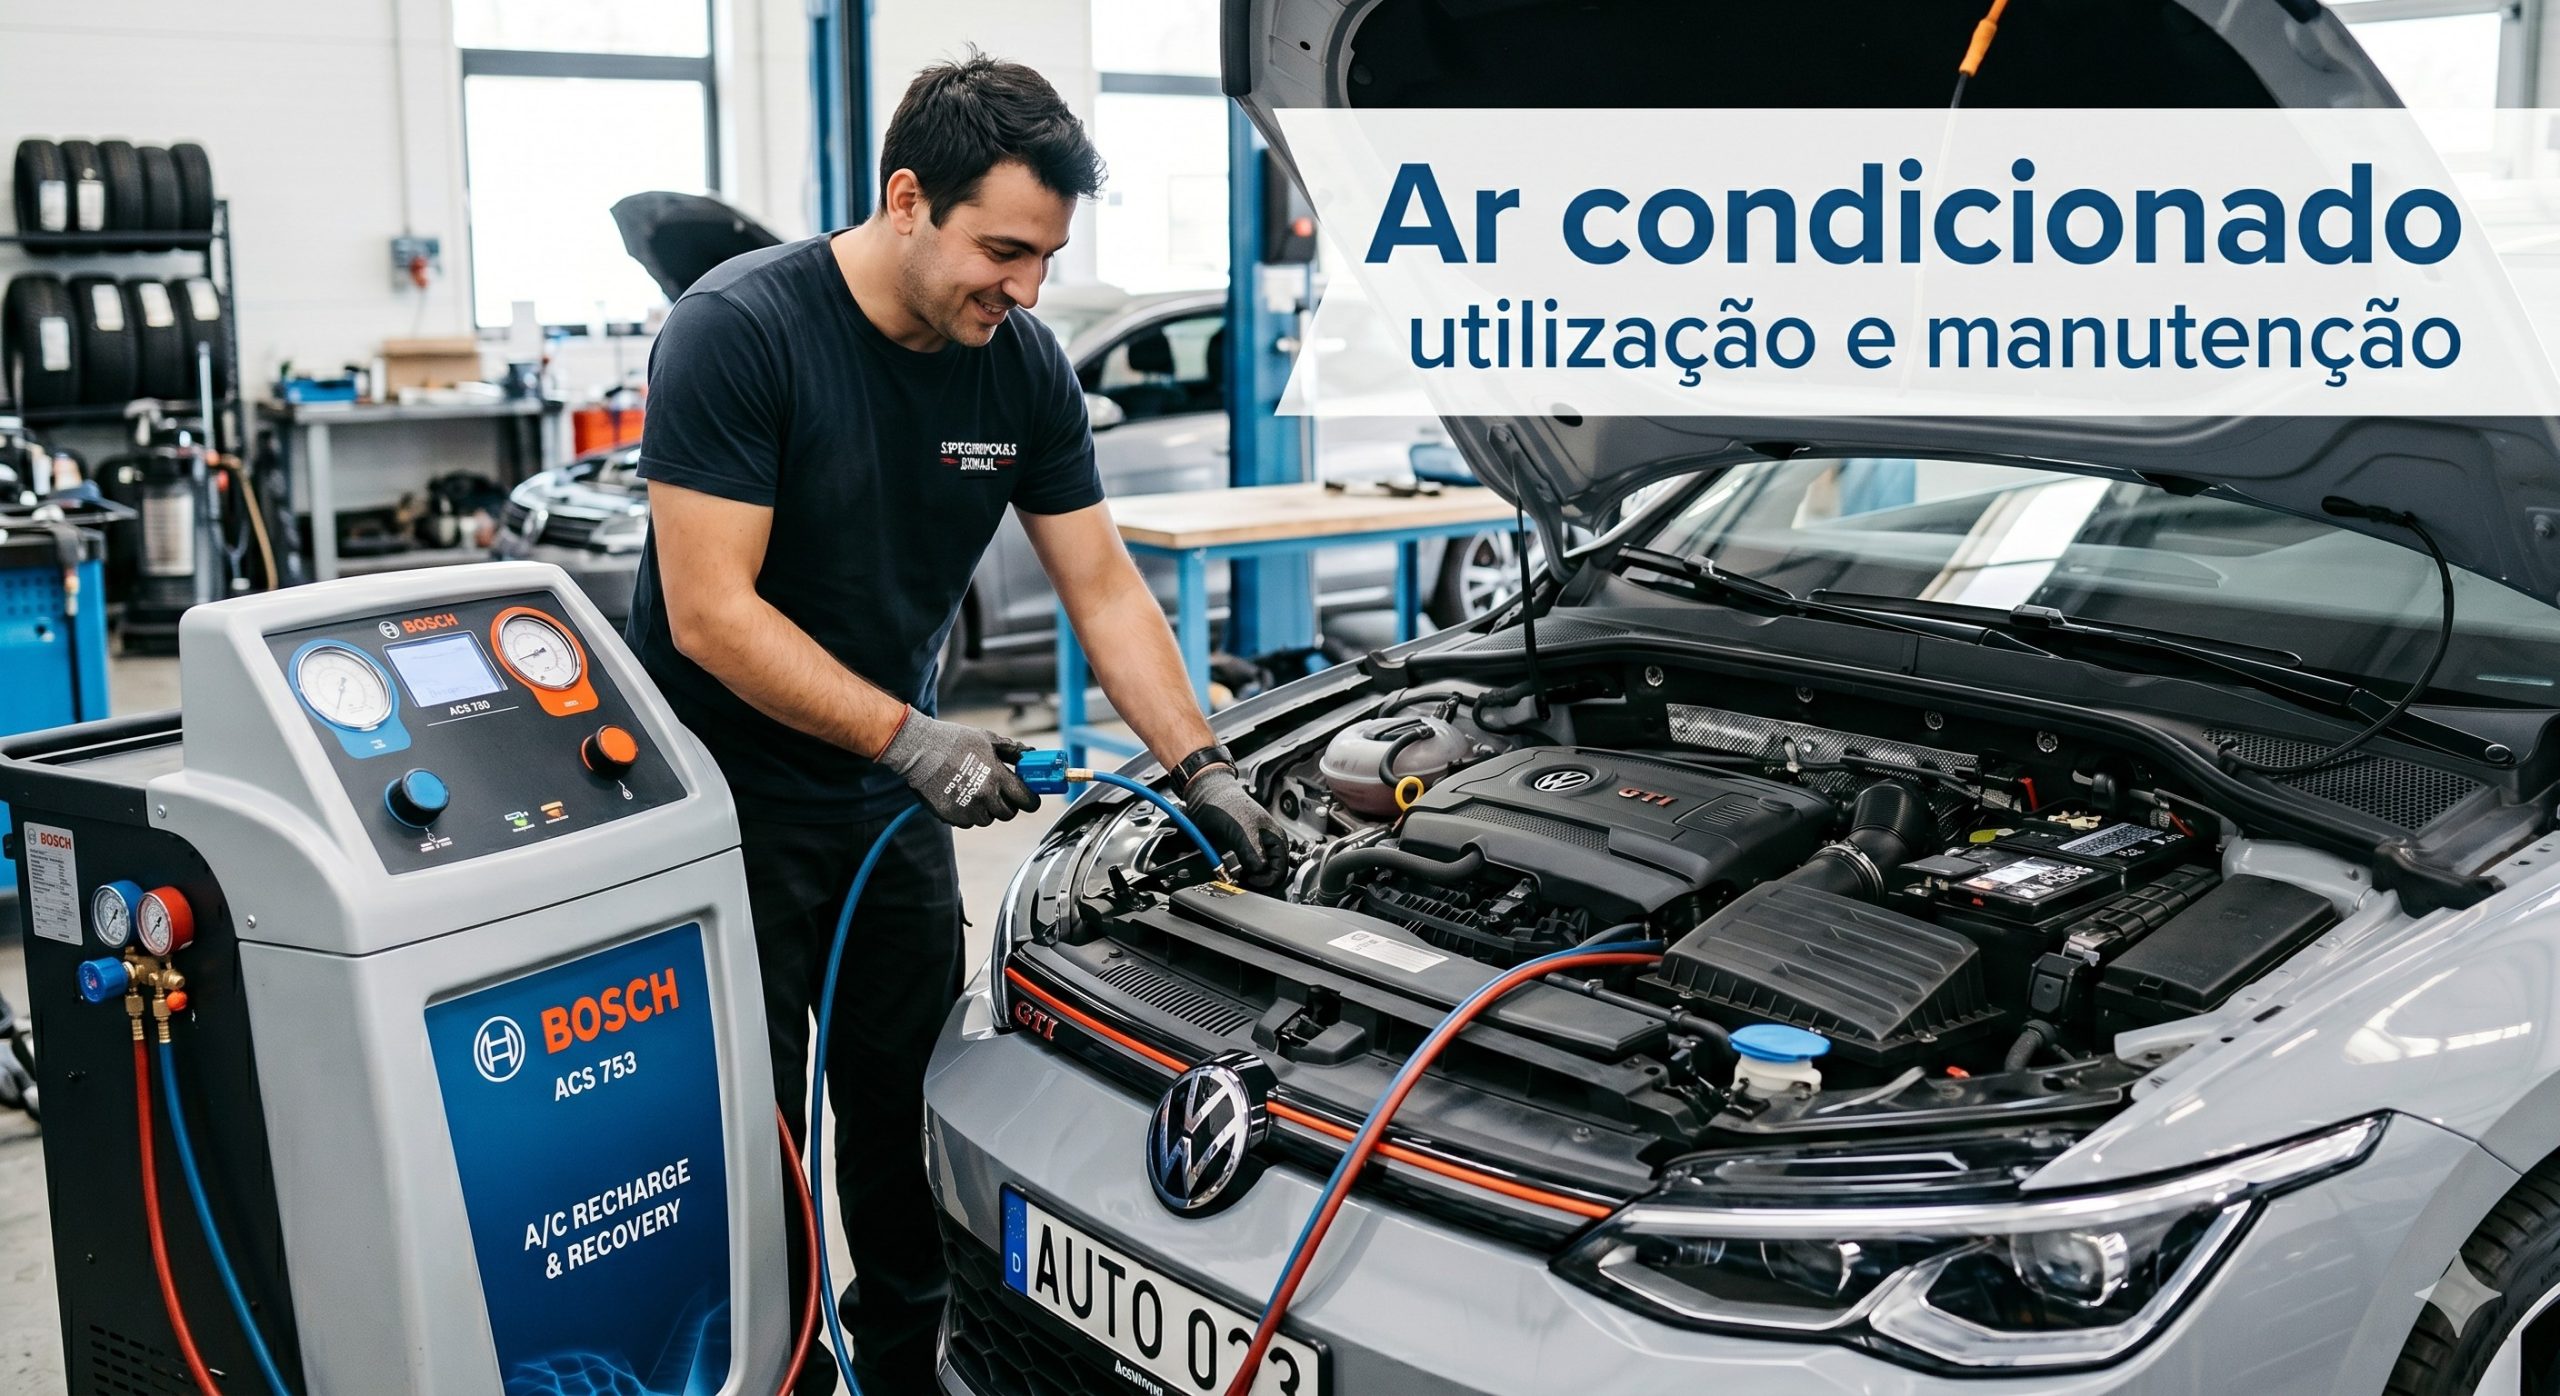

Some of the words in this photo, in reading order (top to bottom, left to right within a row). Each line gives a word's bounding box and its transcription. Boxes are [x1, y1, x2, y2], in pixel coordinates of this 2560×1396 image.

[402, 613, 459, 633] BOSCH
[449, 704, 472, 716] ACS
[1618, 787, 1678, 807] GTI
[40, 832, 72, 850] BOSCH
[540, 967, 680, 1055] BOSCH
[1014, 1001, 1059, 1041] GTI
[554, 1066, 596, 1102] ACS
[600, 1051, 637, 1085] 753
[524, 1211, 567, 1251] A/C
[572, 1158, 691, 1229] RECHARGE
[545, 1252, 563, 1280] &
[568, 1198, 682, 1271] RECOVERY
[1012, 1251, 1022, 1274] D
[1035, 1223, 1163, 1360] AUTO
